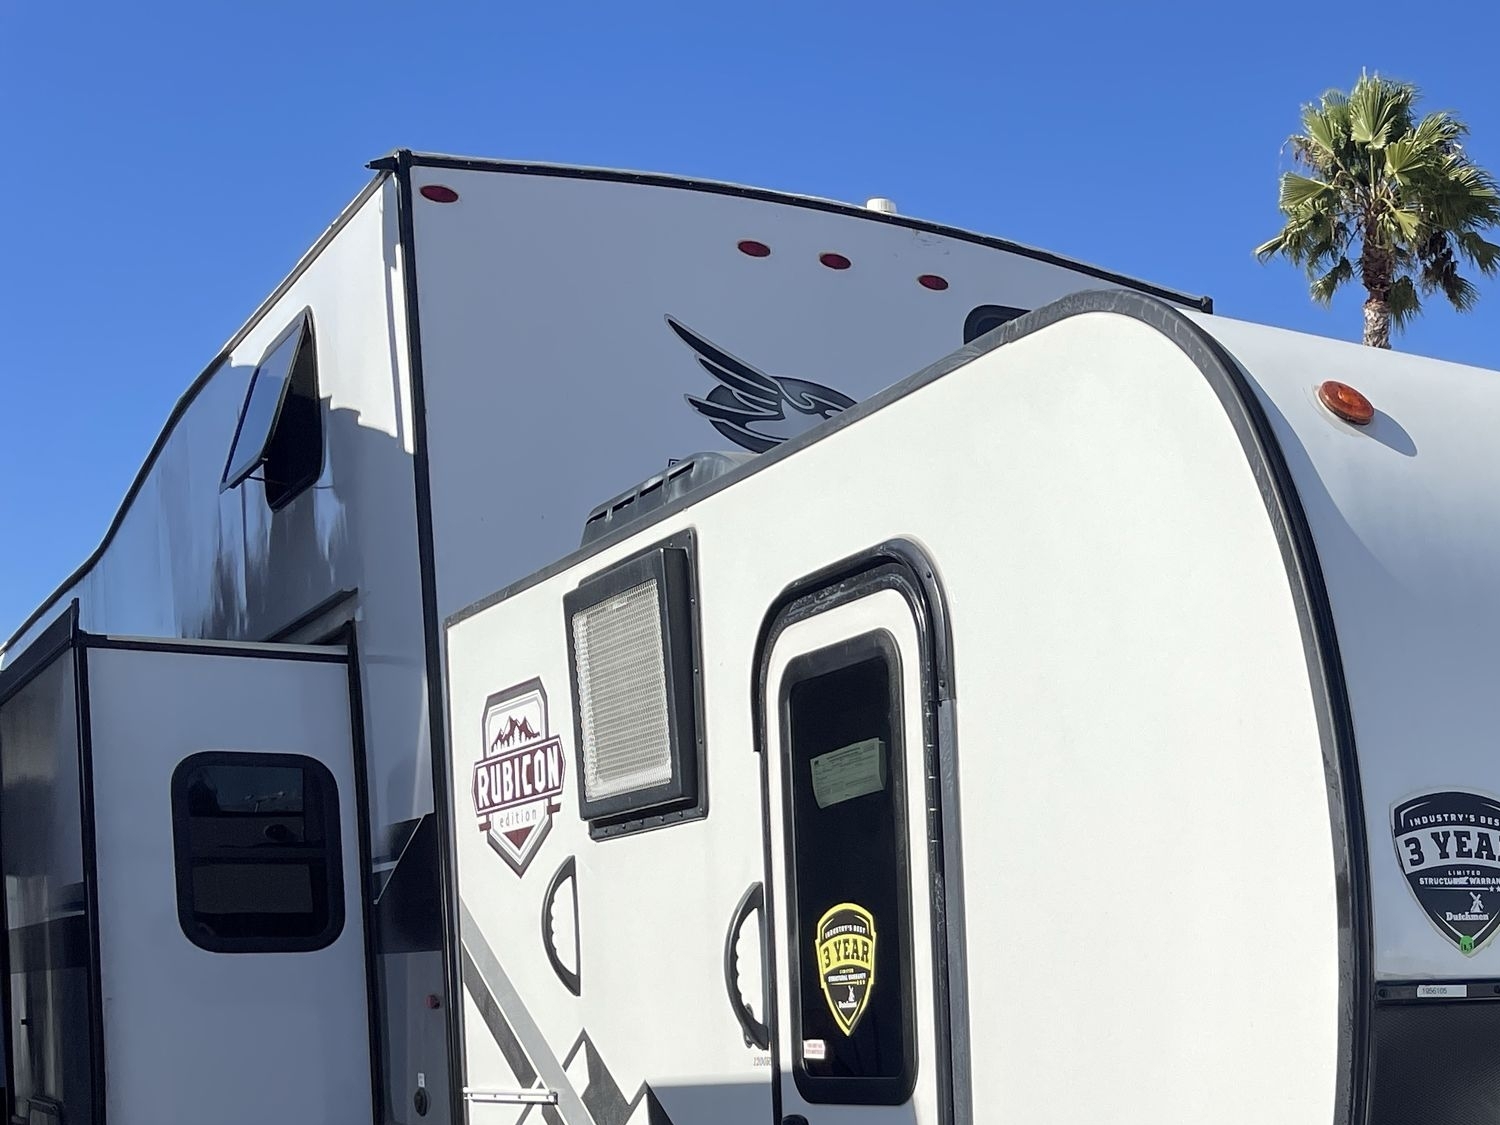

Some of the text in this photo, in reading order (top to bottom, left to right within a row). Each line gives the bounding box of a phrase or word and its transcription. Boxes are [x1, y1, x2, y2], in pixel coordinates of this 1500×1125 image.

[477, 744, 560, 809] RUBICON
[499, 809, 538, 828] edition
[1409, 813, 1476, 827] INDUSTRY'S
[1403, 836, 1425, 867] 3
[823, 938, 870, 969] 3 YEAR
